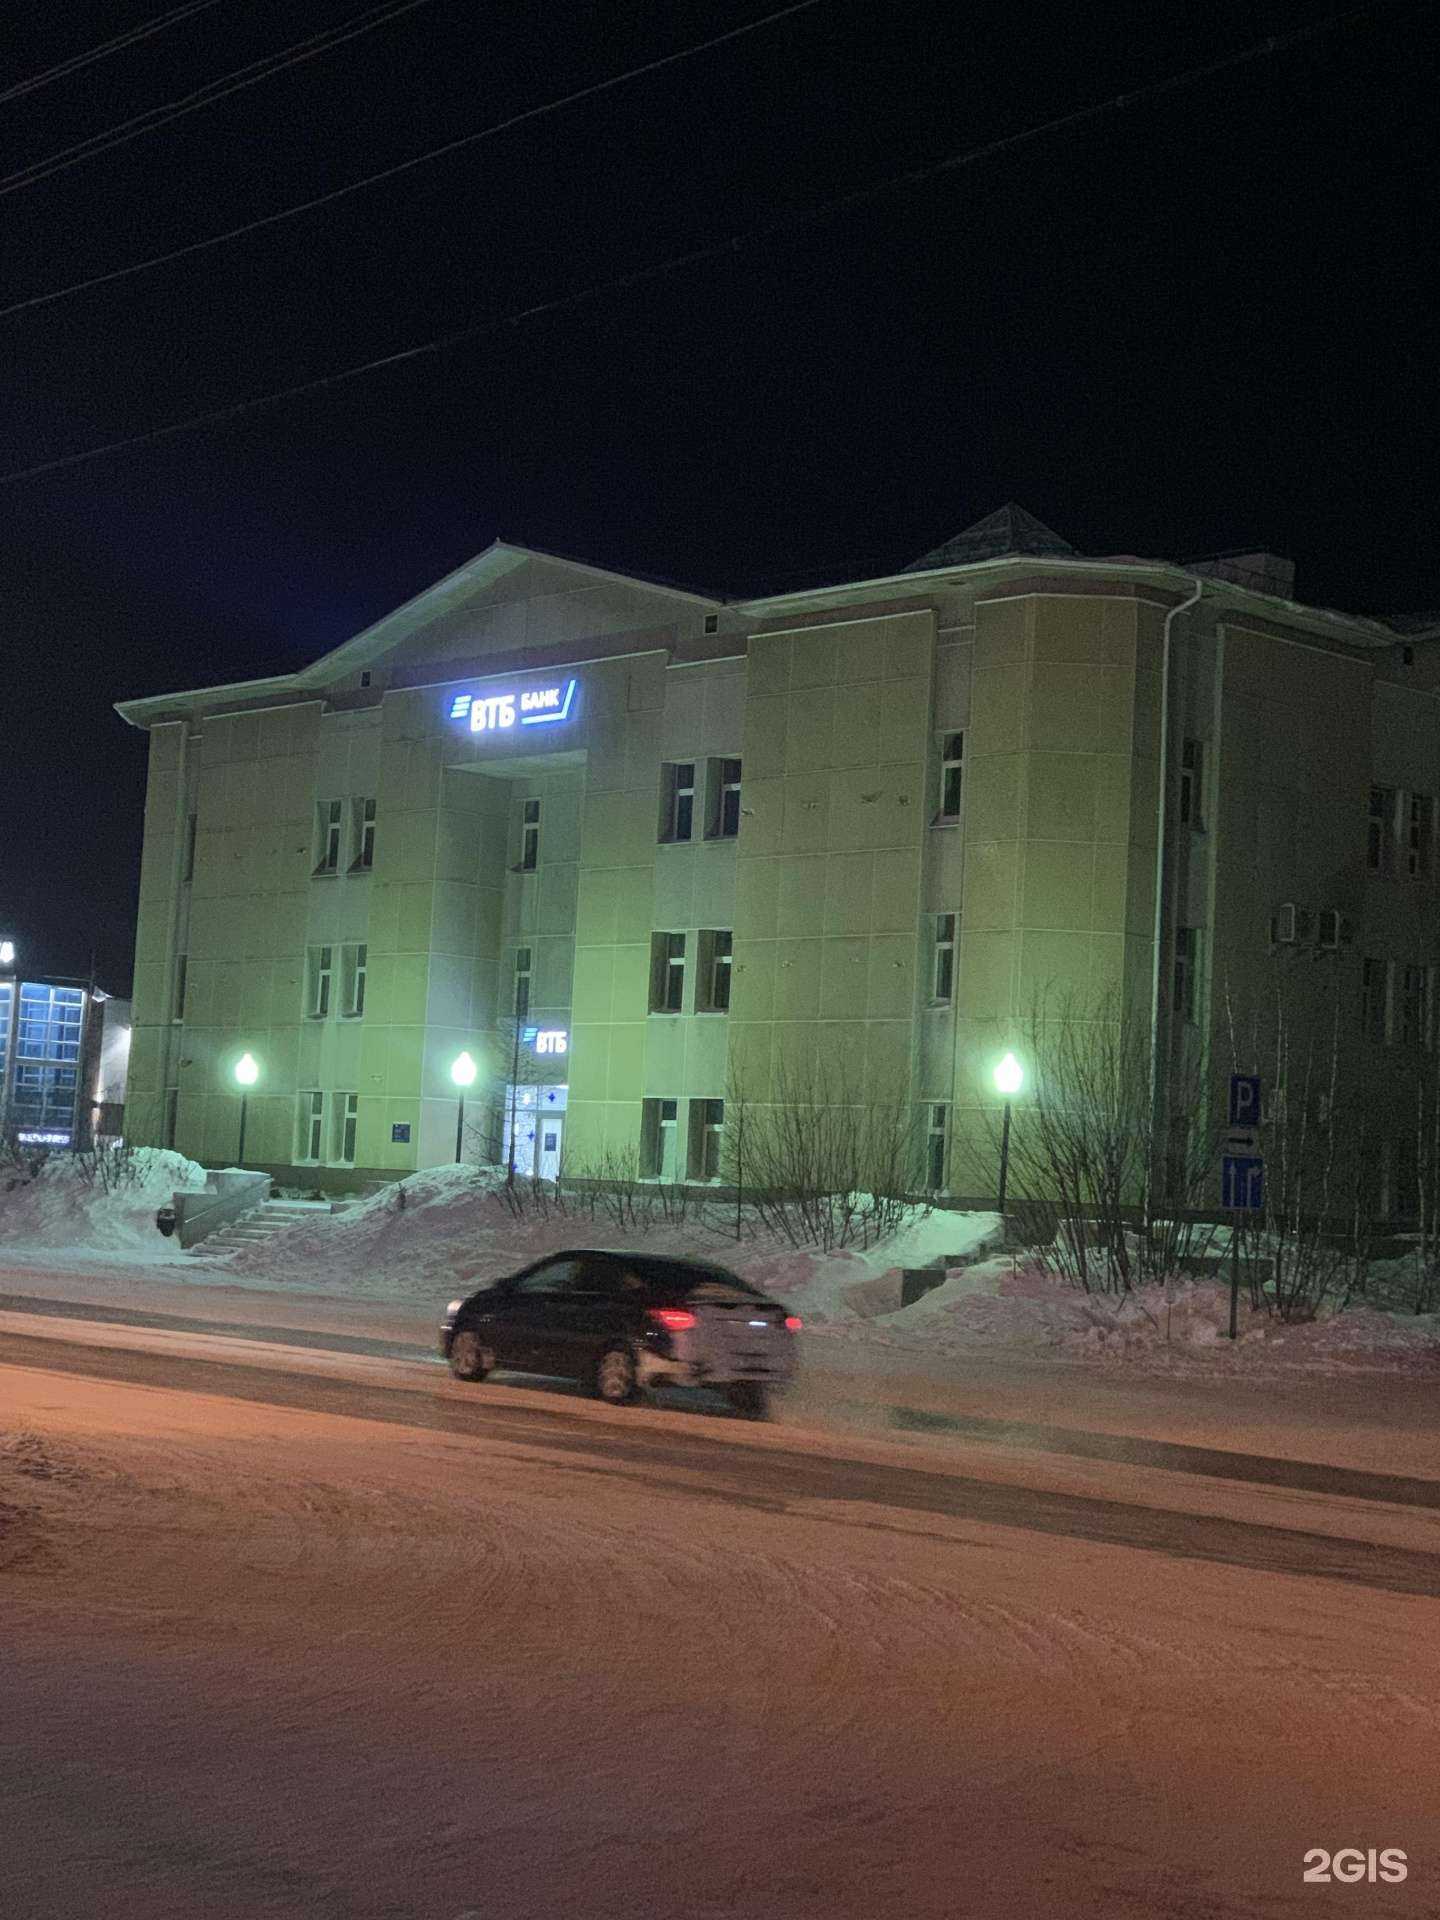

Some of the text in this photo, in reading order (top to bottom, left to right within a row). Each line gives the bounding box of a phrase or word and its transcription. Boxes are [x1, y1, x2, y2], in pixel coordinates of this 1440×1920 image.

[470, 688, 560, 732] ВТБ БАНК
[535, 1031, 568, 1053] ВТБ
[1237, 1081, 1254, 1120] P
